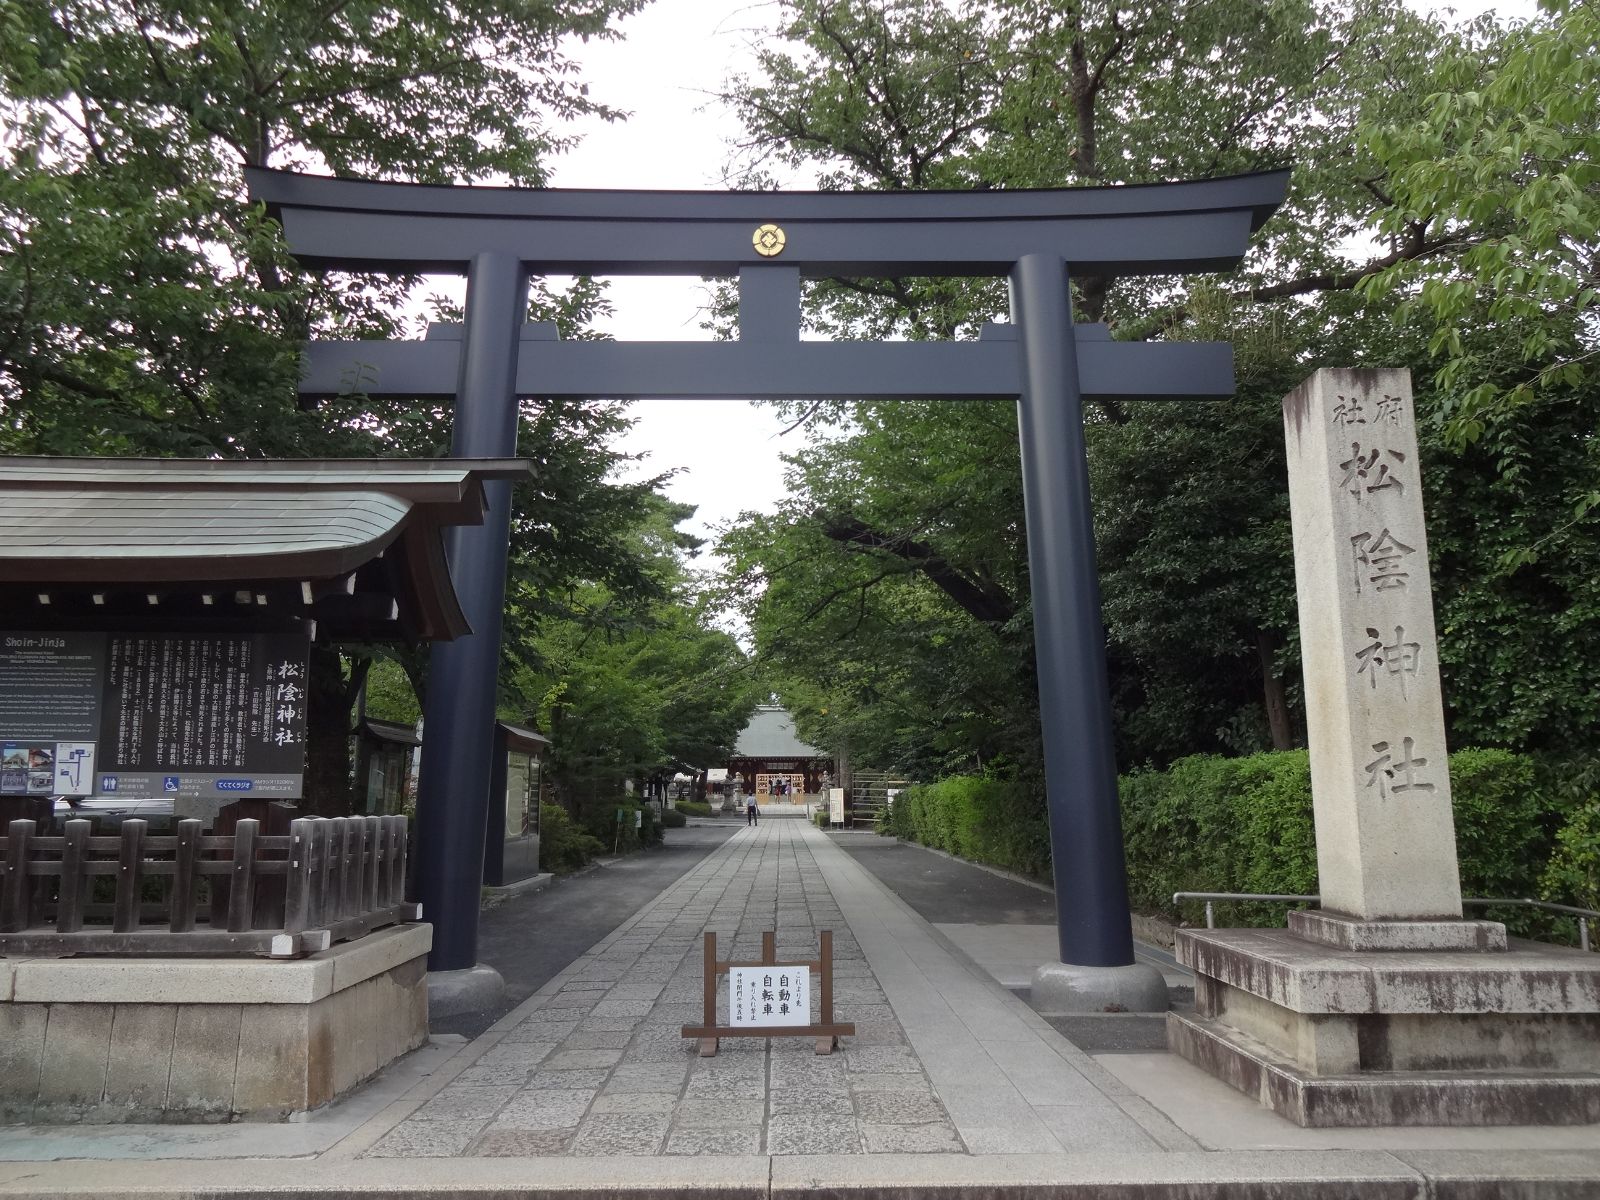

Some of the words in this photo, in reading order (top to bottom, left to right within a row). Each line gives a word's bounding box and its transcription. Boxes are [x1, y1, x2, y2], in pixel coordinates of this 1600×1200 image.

[1339, 441, 1437, 800] 松陰神社
[5, 637, 66, 648] Shoin-Jinja
[275, 660, 299, 746] 松陰神社
[218, 781, 251, 789] てくてくラジオ
[762, 974, 774, 1016] 自転車
[778, 973, 791, 1016] 自動車
